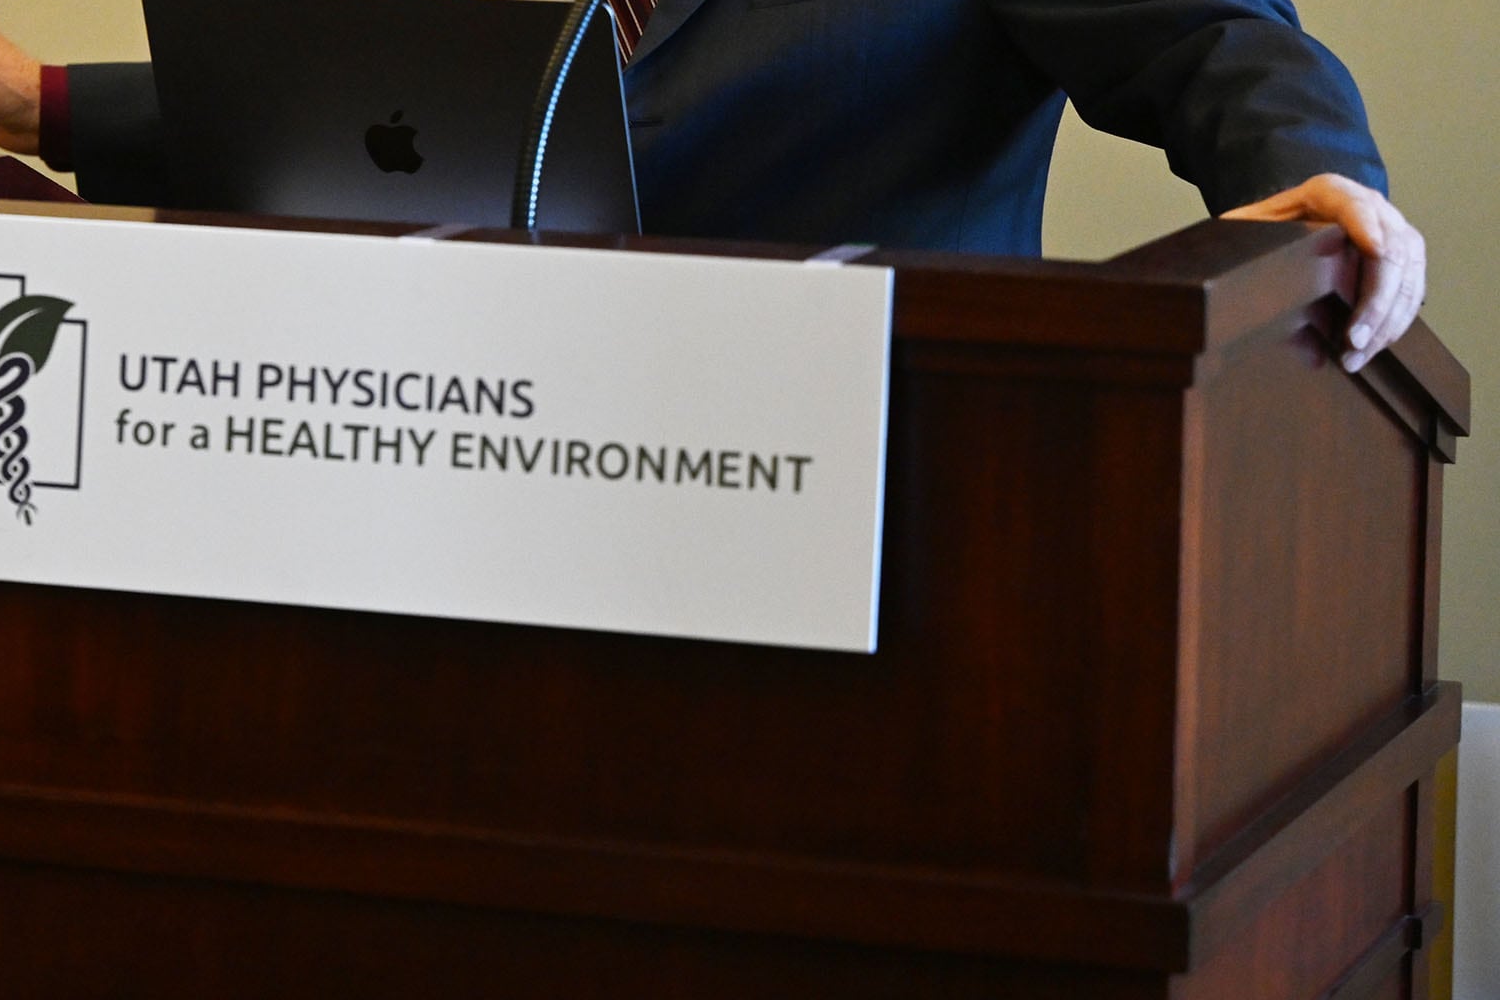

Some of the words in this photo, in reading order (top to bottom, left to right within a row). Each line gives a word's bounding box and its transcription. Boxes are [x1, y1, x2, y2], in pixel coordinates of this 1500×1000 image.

[119, 353, 240, 398] UTAH
[257, 363, 535, 419] PHYSICIANS
[115, 408, 176, 447] for
[189, 424, 210, 450] a
[225, 415, 436, 467] HEALTHY
[451, 432, 812, 492] ENVIRONMENT
